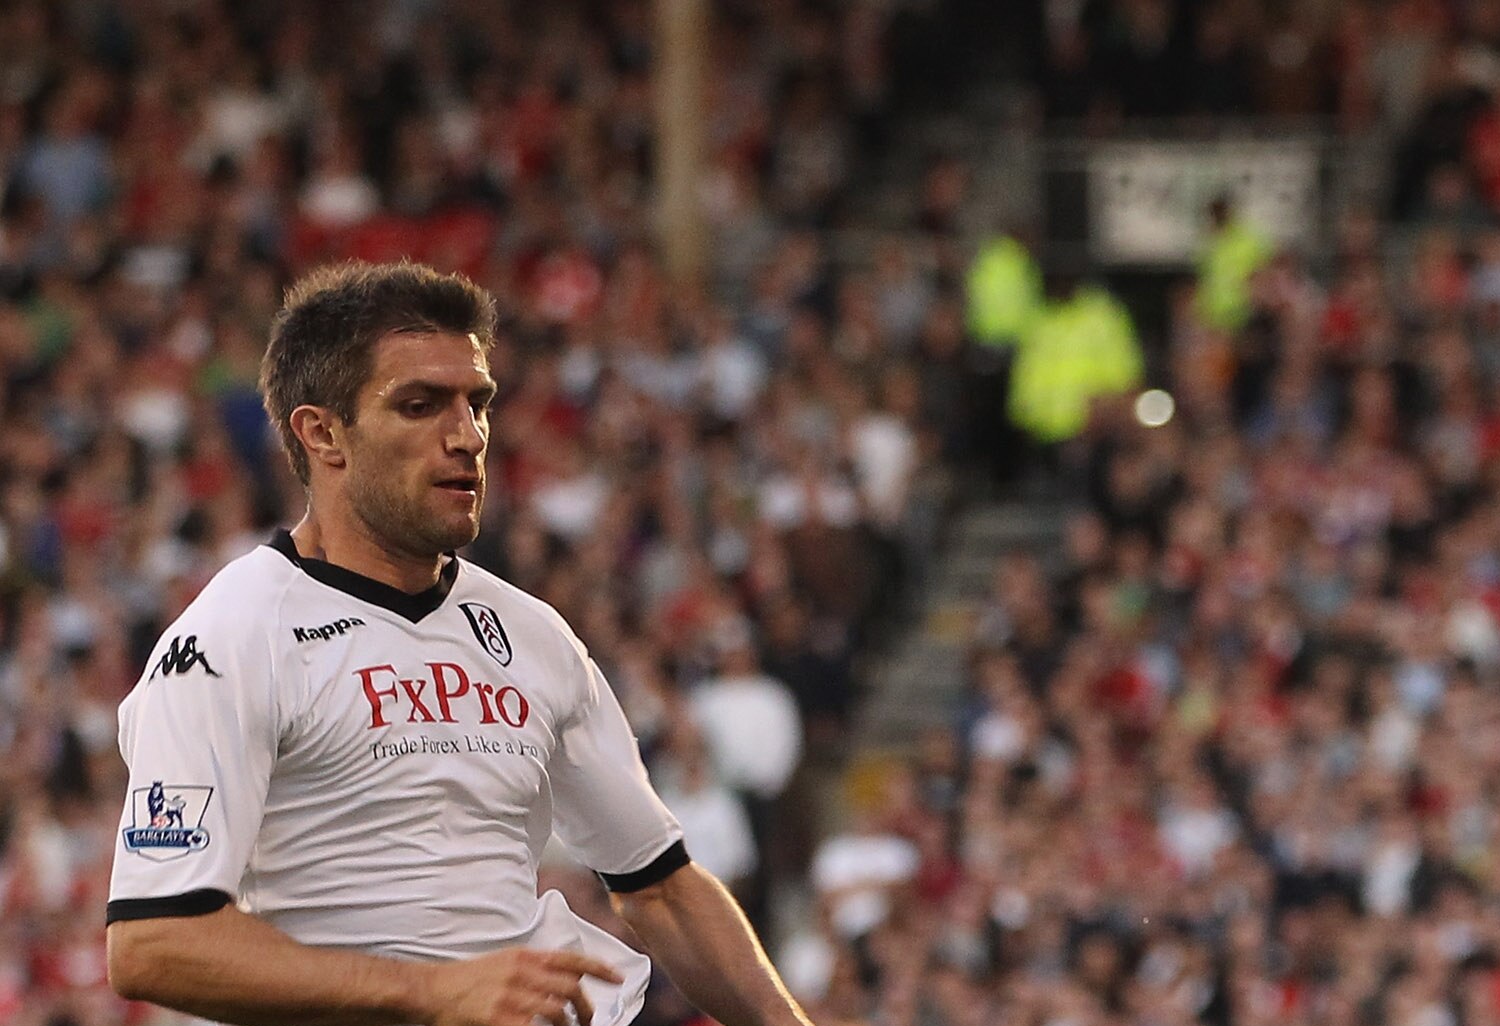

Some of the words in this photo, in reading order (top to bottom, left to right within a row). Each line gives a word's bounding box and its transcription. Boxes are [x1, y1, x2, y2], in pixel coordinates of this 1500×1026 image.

[292, 617, 367, 643] Kappa
[352, 662, 530, 730] FxPro
[369, 735, 418, 760] Trade
[419, 735, 459, 754] Forex
[464, 734, 500, 754] Like
[504, 740, 515, 755] a
[133, 830, 186, 843] BARCLAYS
